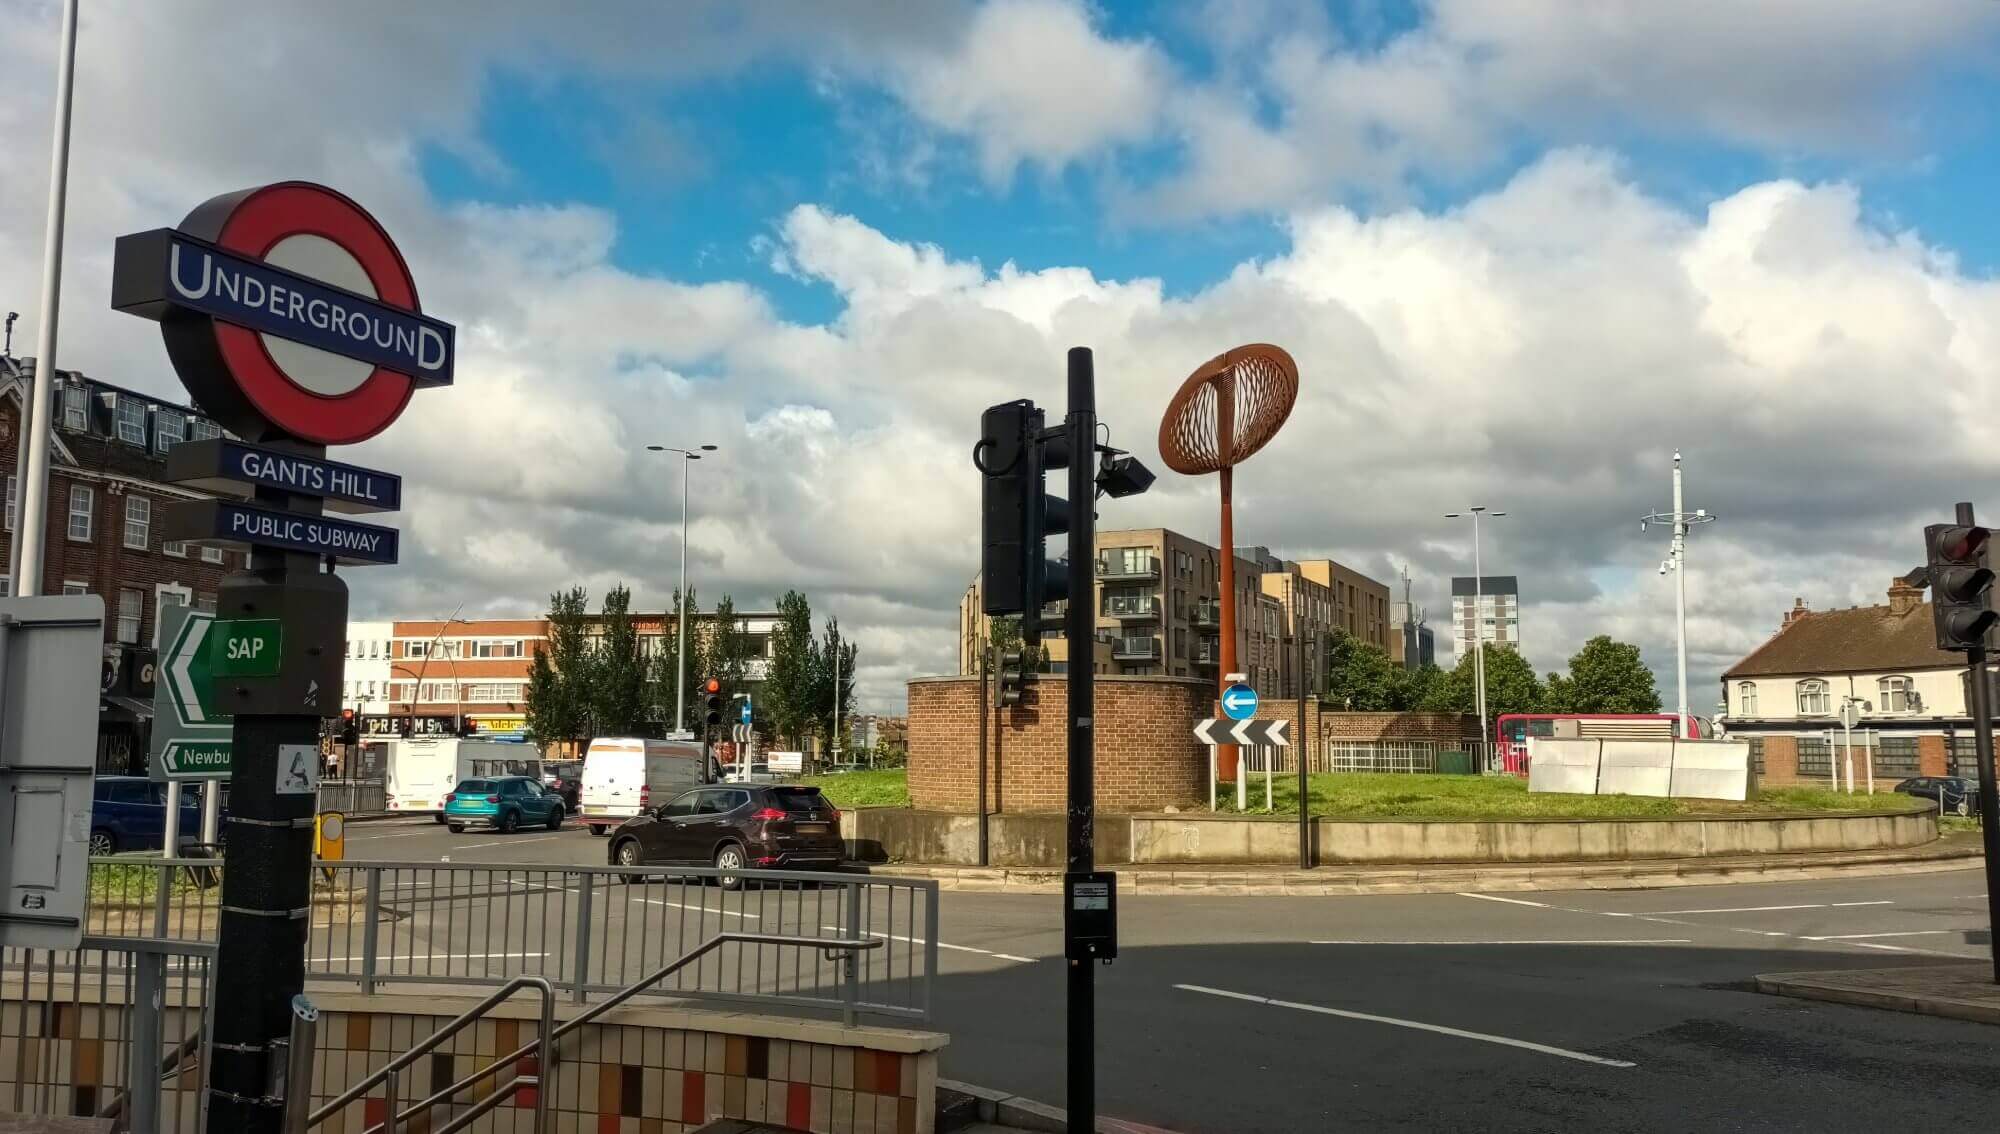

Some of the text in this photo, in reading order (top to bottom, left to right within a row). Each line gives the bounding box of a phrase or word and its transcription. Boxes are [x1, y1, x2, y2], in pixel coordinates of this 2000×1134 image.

[170, 244, 446, 370] UNDERGROUND
[242, 453, 378, 500] GANTS HILL
[233, 513, 381, 552] PUBLIC SUBWAY
[227, 637, 264, 659] SAP
[369, 718, 435, 733] DREMS
[183, 748, 230, 765] Newbu
